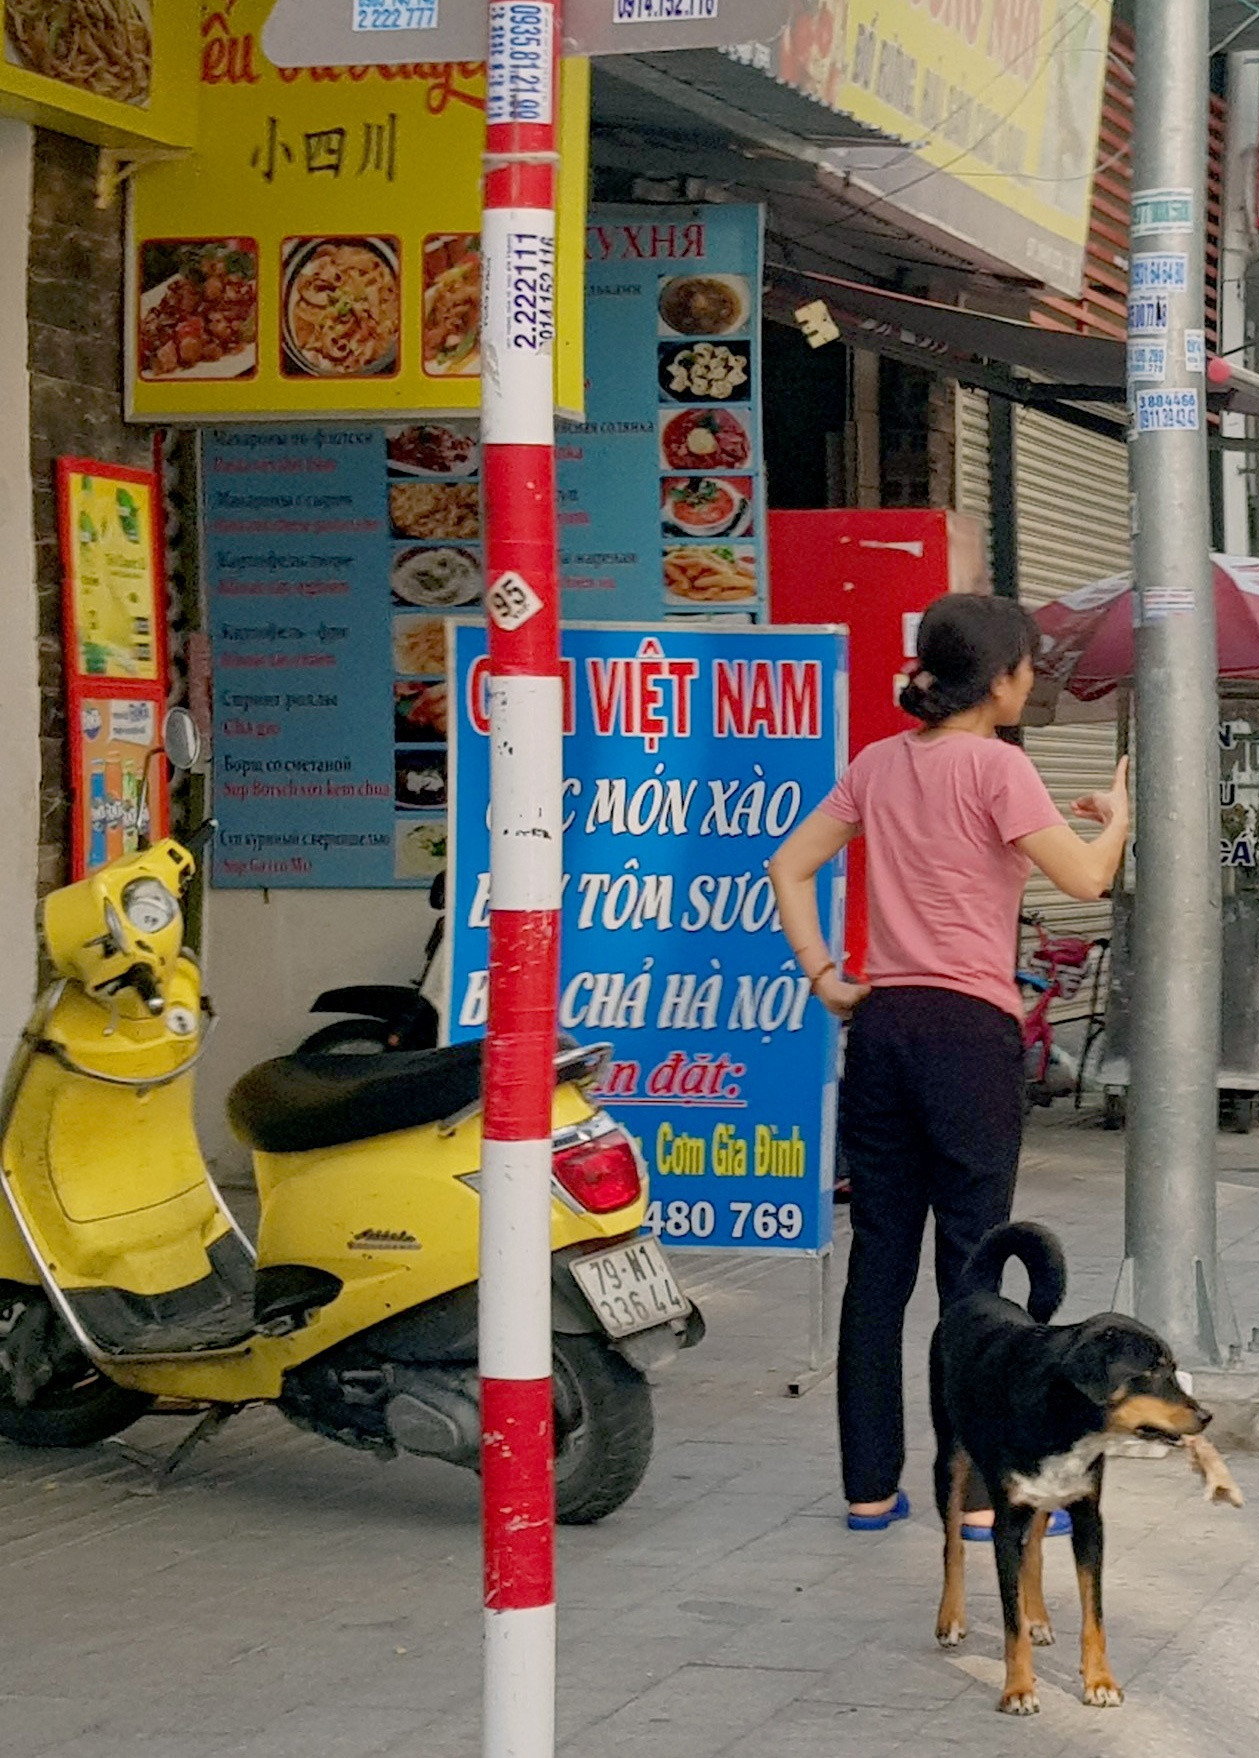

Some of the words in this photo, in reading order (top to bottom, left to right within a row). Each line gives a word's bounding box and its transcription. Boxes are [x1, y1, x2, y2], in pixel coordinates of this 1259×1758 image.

[250, 113, 398, 182] 小四川
[513, 233, 538, 350] 2.222111
[587, 638, 698, 752] VIỆT
[713, 661, 821, 737] NAM
[586, 763, 698, 835] MÓN
[701, 764, 801, 836] XÀO
[578, 858, 673, 930] TÔM
[681, 859, 783, 932] SƯỜ
[561, 957, 652, 1029] CHẢ
[657, 959, 724, 1030] HÀ
[728, 960, 812, 1043] NỘI
[656, 1122, 705, 1176] Cơm
[711, 1123, 747, 1177] Gia
[754, 1123, 806, 1179] Đình
[642, 1200, 715, 1238] 480
[729, 1201, 803, 1239] 769
